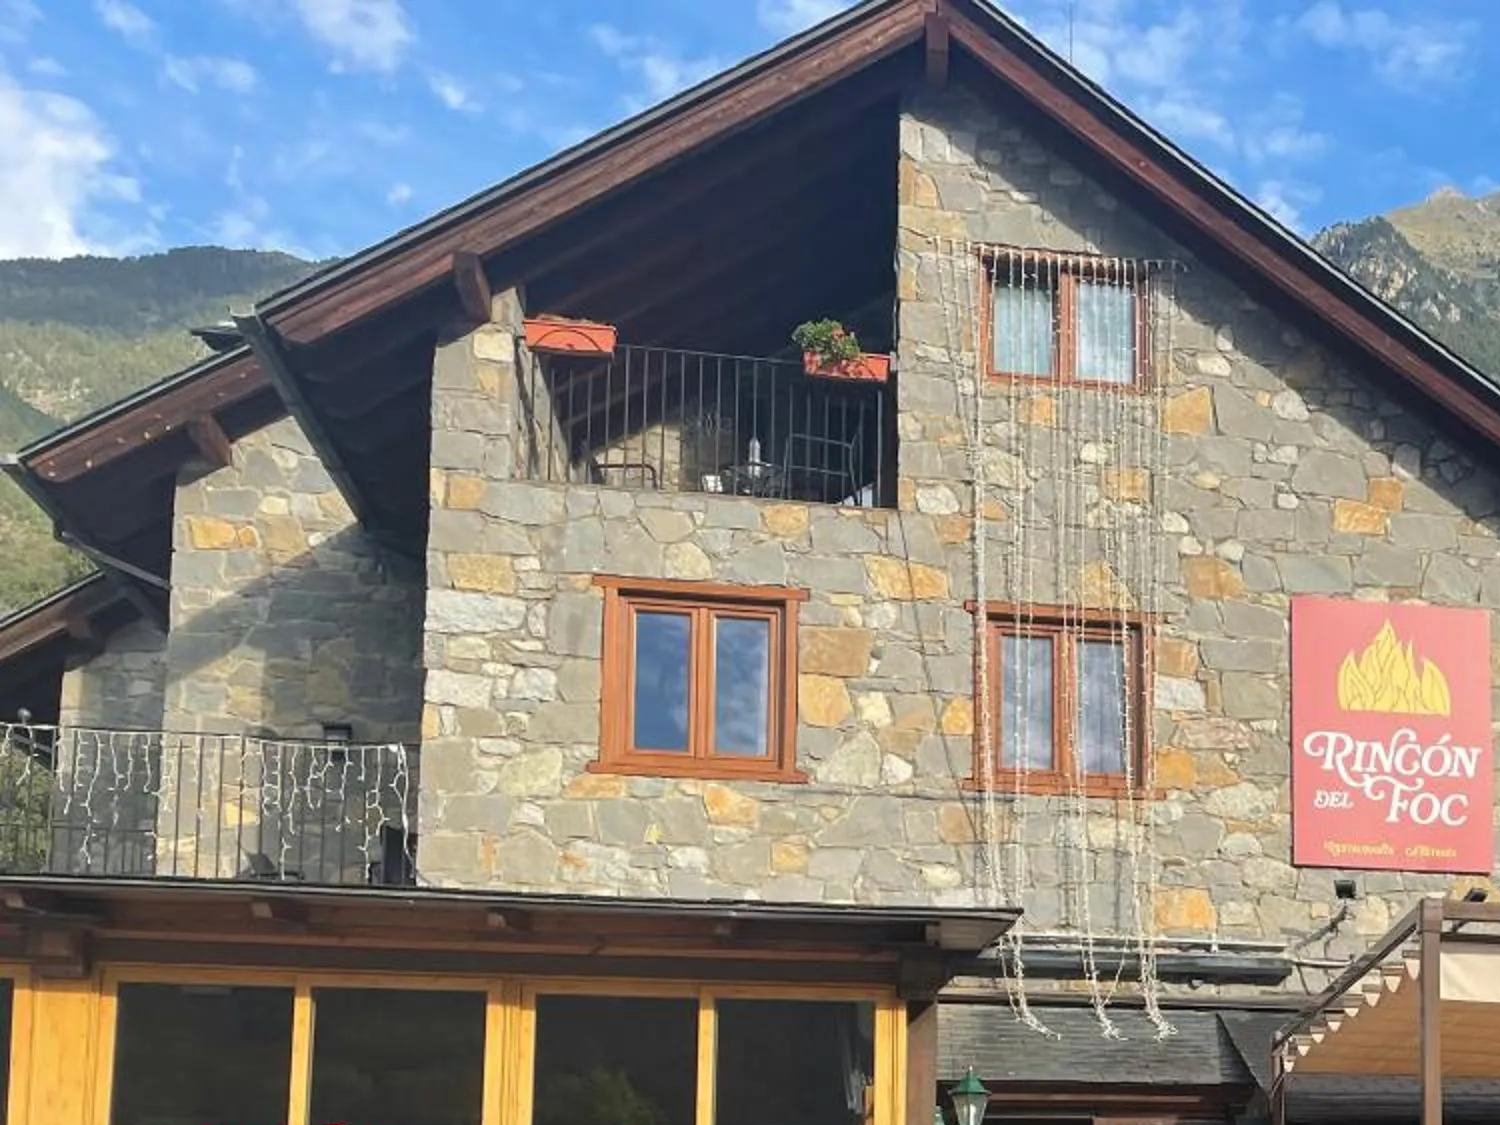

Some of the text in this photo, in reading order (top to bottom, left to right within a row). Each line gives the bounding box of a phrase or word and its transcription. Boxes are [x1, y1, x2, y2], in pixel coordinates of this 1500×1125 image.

[1303, 728, 1482, 788] RINCÓN
[1313, 773, 1468, 826] DEL FOC
